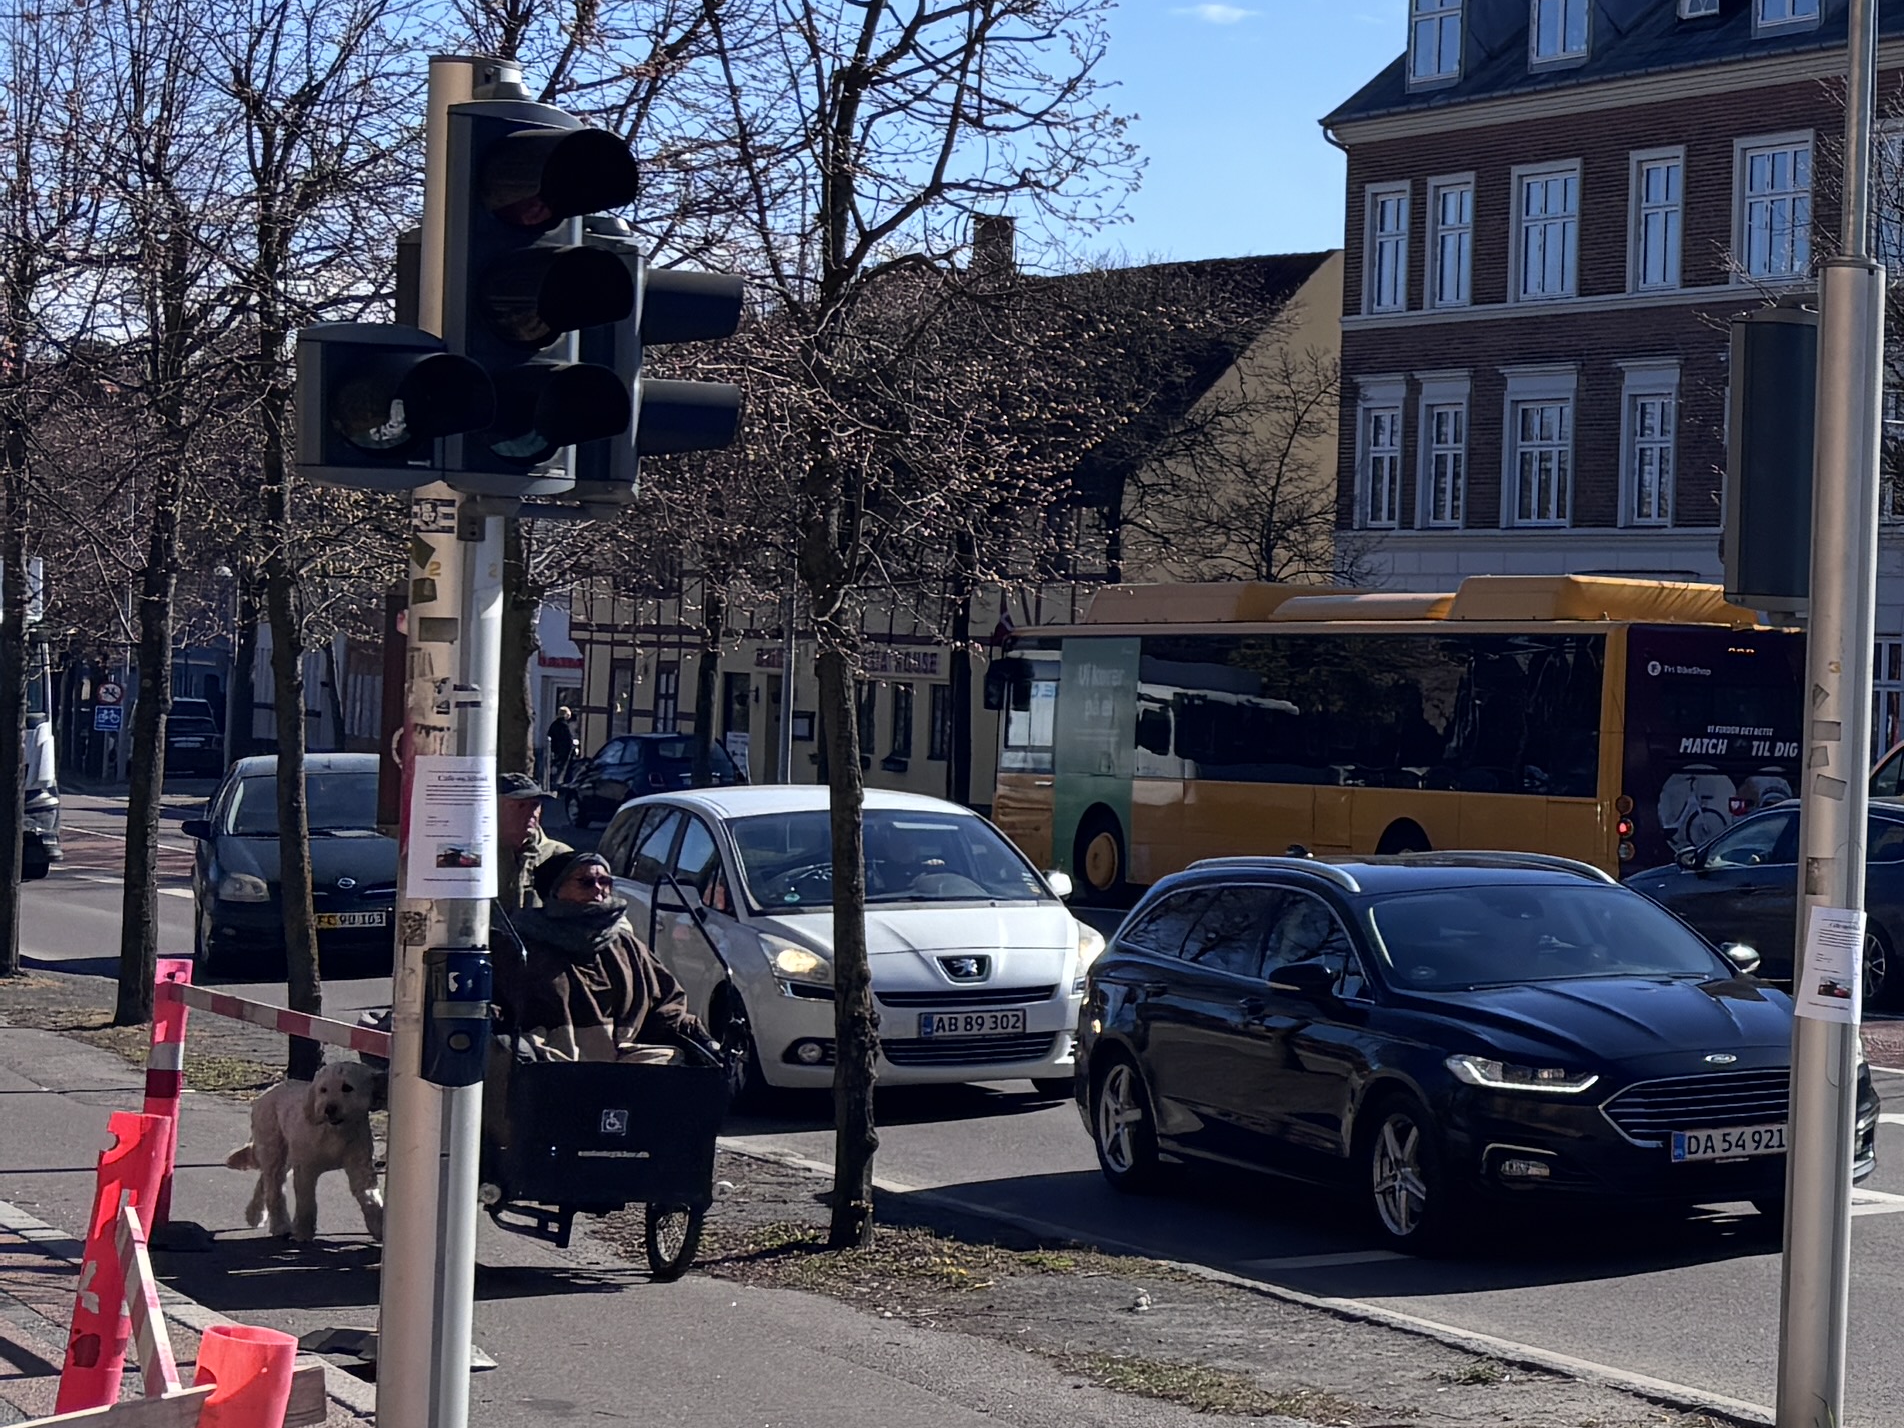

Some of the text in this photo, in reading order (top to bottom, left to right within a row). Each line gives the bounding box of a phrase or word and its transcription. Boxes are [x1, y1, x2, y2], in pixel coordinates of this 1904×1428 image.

[1679, 738, 1798, 757] MATCH TIL DIG
[935, 1014, 1020, 1032] AB 89 302
[1687, 1129, 1785, 1154] DA 54 921
